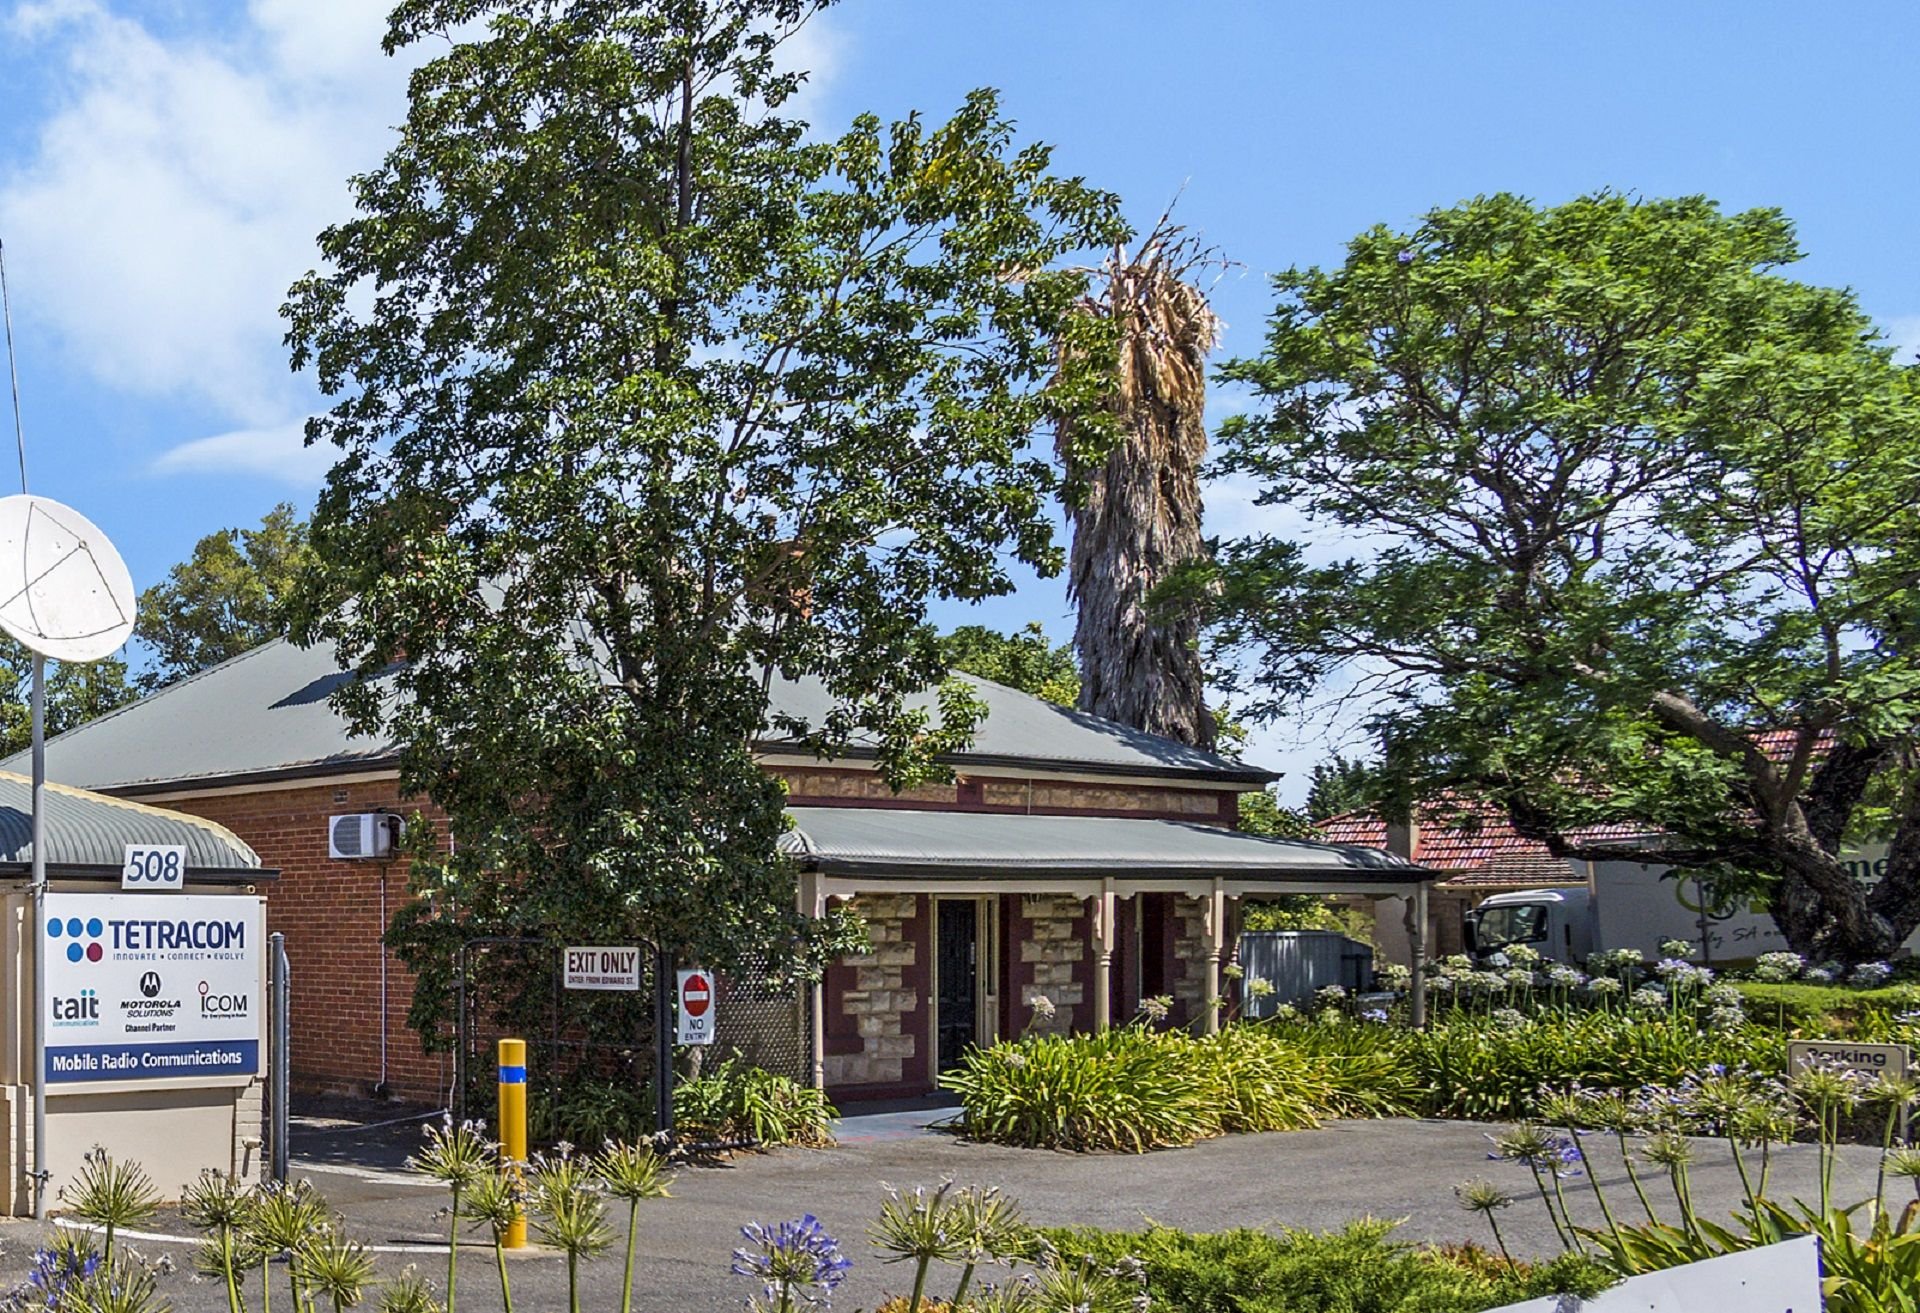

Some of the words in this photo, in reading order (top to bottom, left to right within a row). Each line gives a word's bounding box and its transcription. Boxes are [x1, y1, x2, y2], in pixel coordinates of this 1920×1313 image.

[127, 850, 179, 882] 508
[108, 920, 244, 949] TETRACOM
[113, 953, 156, 961] INNOVATE
[167, 952, 205, 960] CONNECT
[214, 952, 244, 960] EVOLVE
[568, 952, 597, 973] EXIT
[601, 952, 635, 974] ONLY
[53, 989, 99, 1020] tait
[120, 1000, 181, 1009] MOTOROLA
[127, 1009, 174, 1018] SOLUTIONS
[152, 1022, 176, 1032] Partner
[689, 1018, 704, 1030] NO
[685, 1032, 706, 1041] ENTRY
[53, 1054, 98, 1072] Mobile
[101, 1052, 139, 1070] Radio
[141, 1049, 242, 1068] Communications
